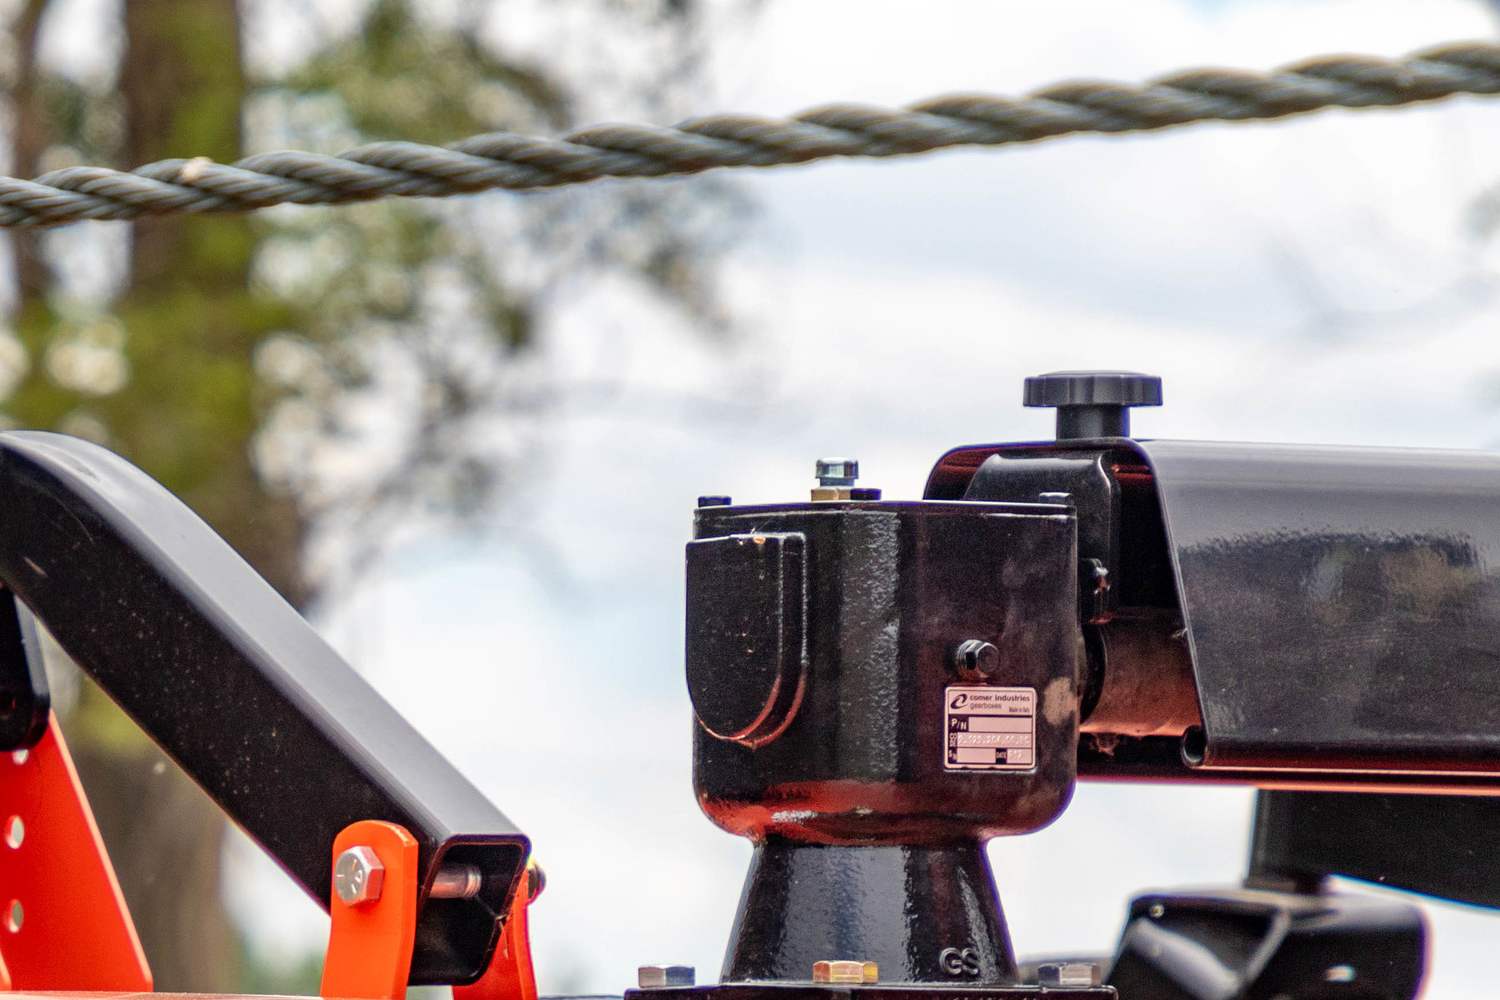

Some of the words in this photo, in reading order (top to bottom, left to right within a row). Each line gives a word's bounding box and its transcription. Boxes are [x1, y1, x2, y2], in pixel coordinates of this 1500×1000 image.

[995, 694, 1030, 702] industries
[970, 702, 1002, 710] gearboxes
[951, 718, 967, 730] P/N
[939, 947, 980, 975] GS
